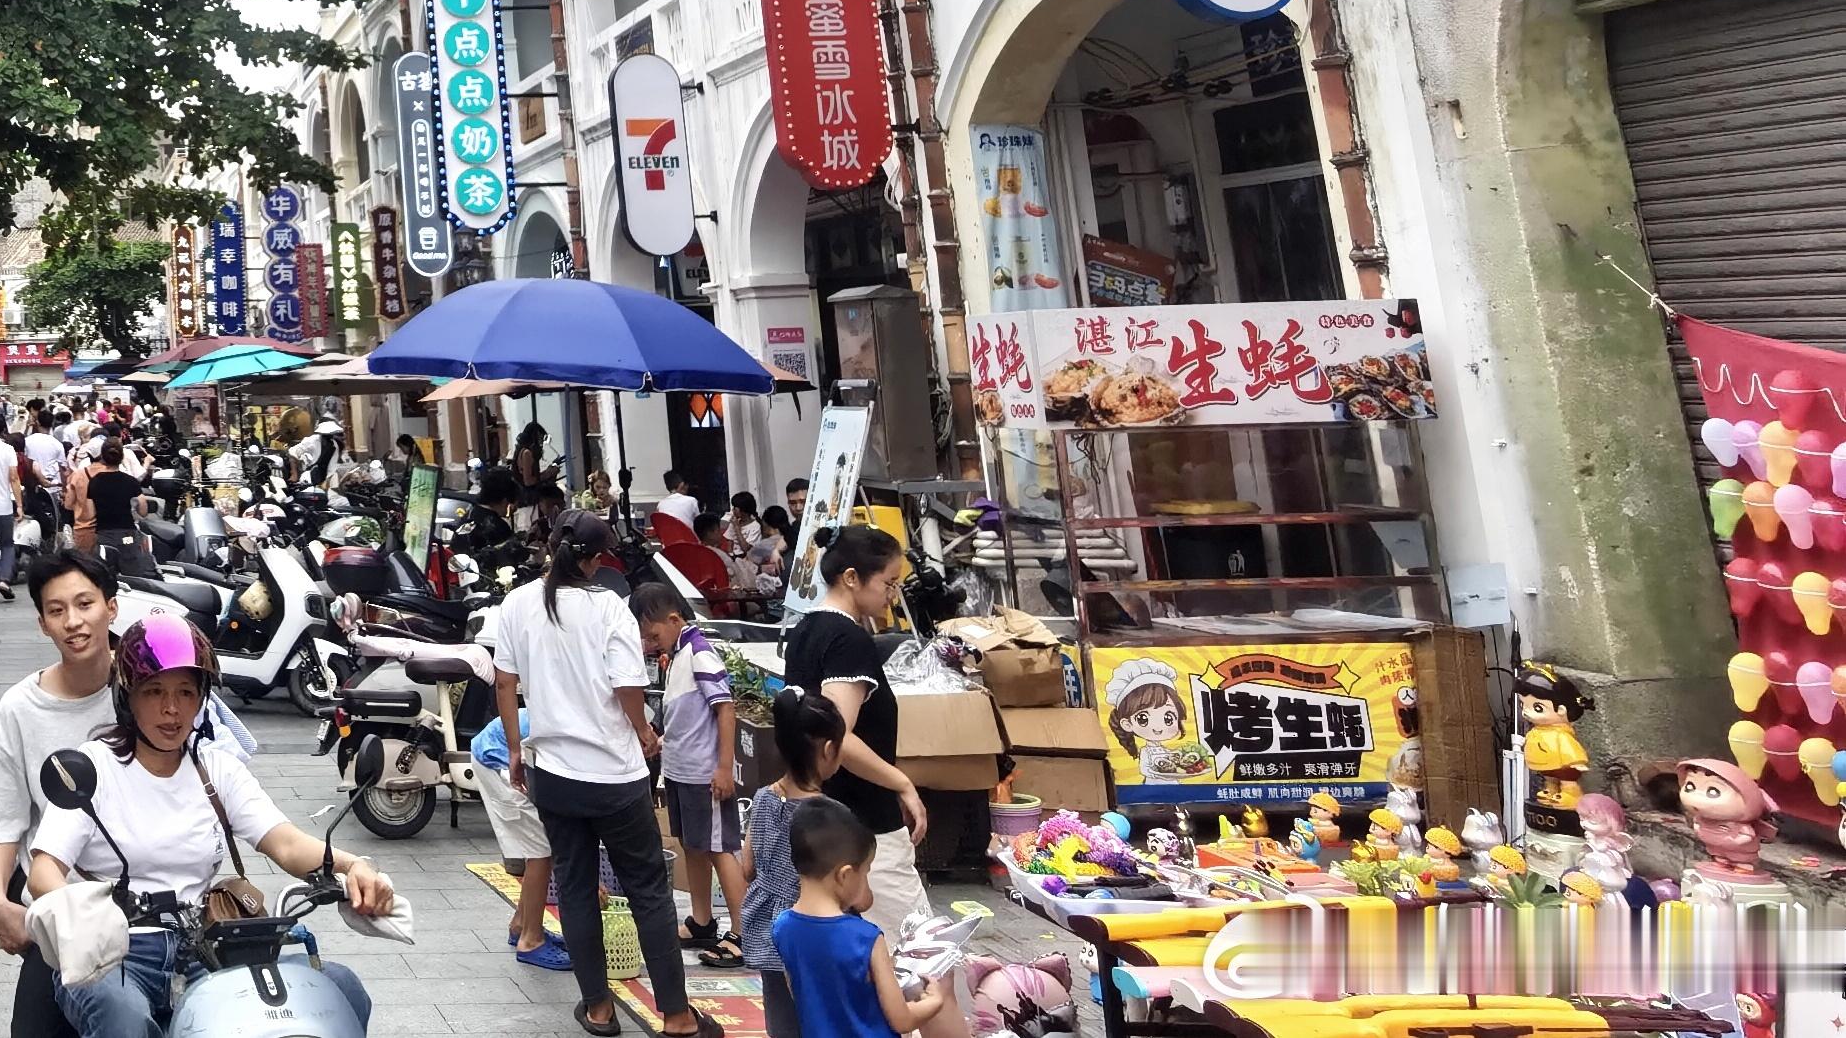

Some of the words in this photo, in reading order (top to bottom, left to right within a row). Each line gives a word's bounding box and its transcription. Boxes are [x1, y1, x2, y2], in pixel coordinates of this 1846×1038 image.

[219, 222, 239, 318] 瑞幸咖啡
[971, 321, 1034, 394] 生蚝
[1074, 316, 1167, 357] 湛江
[1167, 318, 1335, 409] 生蚝
[1201, 688, 1366, 756] 烤生蚝
[1238, 762, 1291, 777] 鲜嫩多汁
[1304, 761, 1357, 777] 爽滑弹牙
